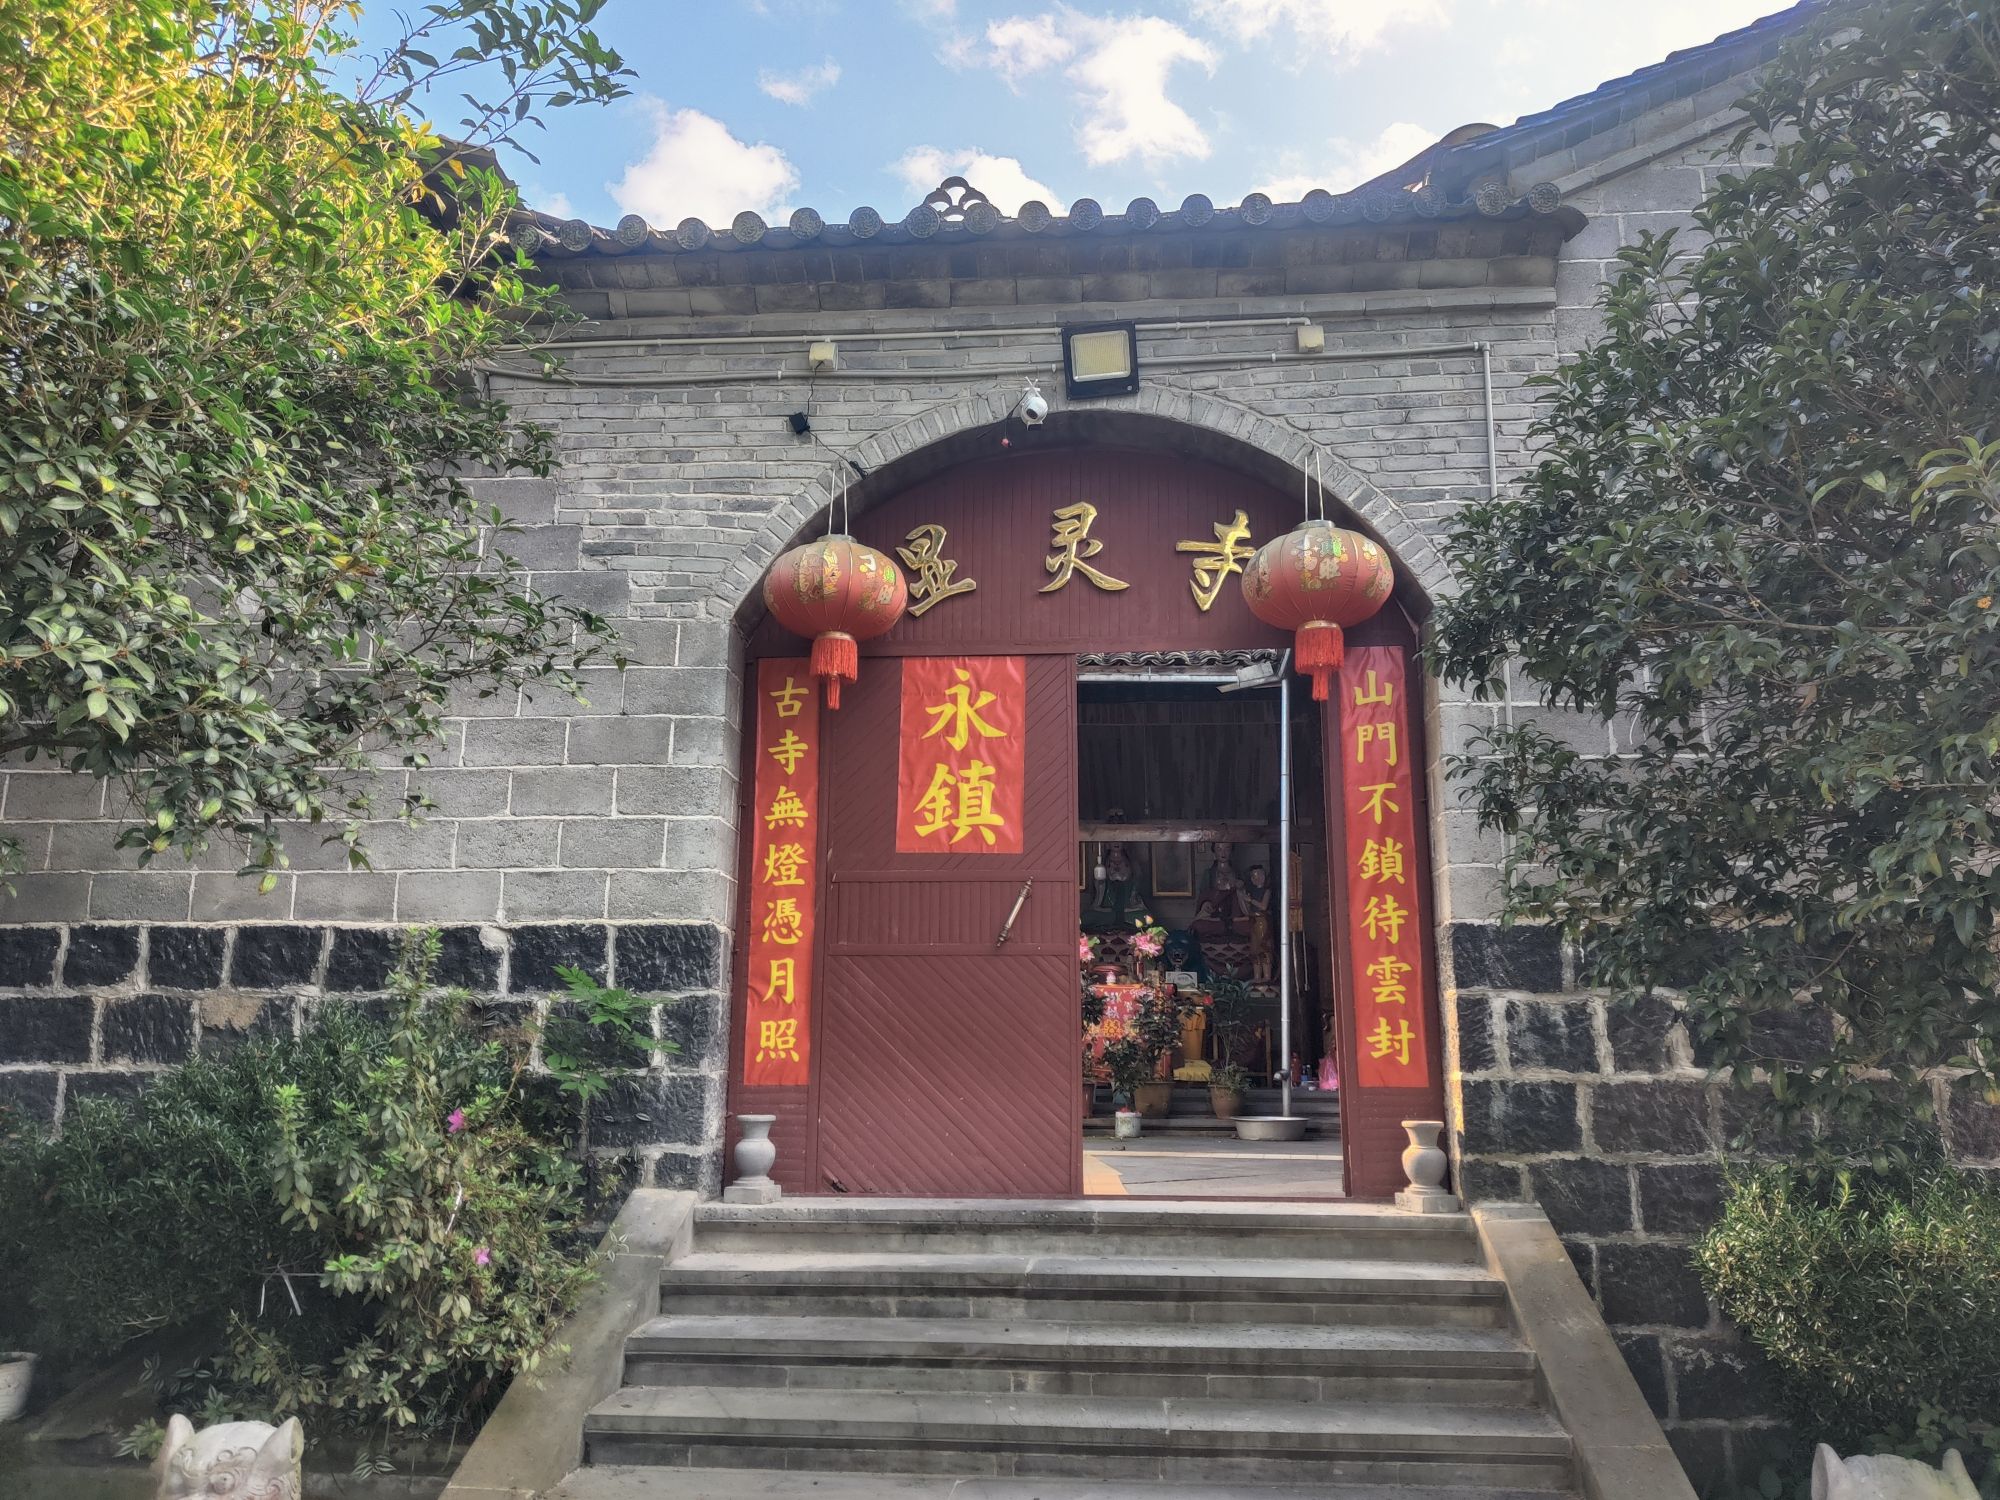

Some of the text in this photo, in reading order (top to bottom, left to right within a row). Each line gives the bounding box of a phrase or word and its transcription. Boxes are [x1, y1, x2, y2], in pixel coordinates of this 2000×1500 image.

[756, 677, 809, 1063] 古寺無燈憑月照
[912, 668, 1008, 846] 永鎮
[1353, 669, 1416, 1067] 山門不鎖待雲封
